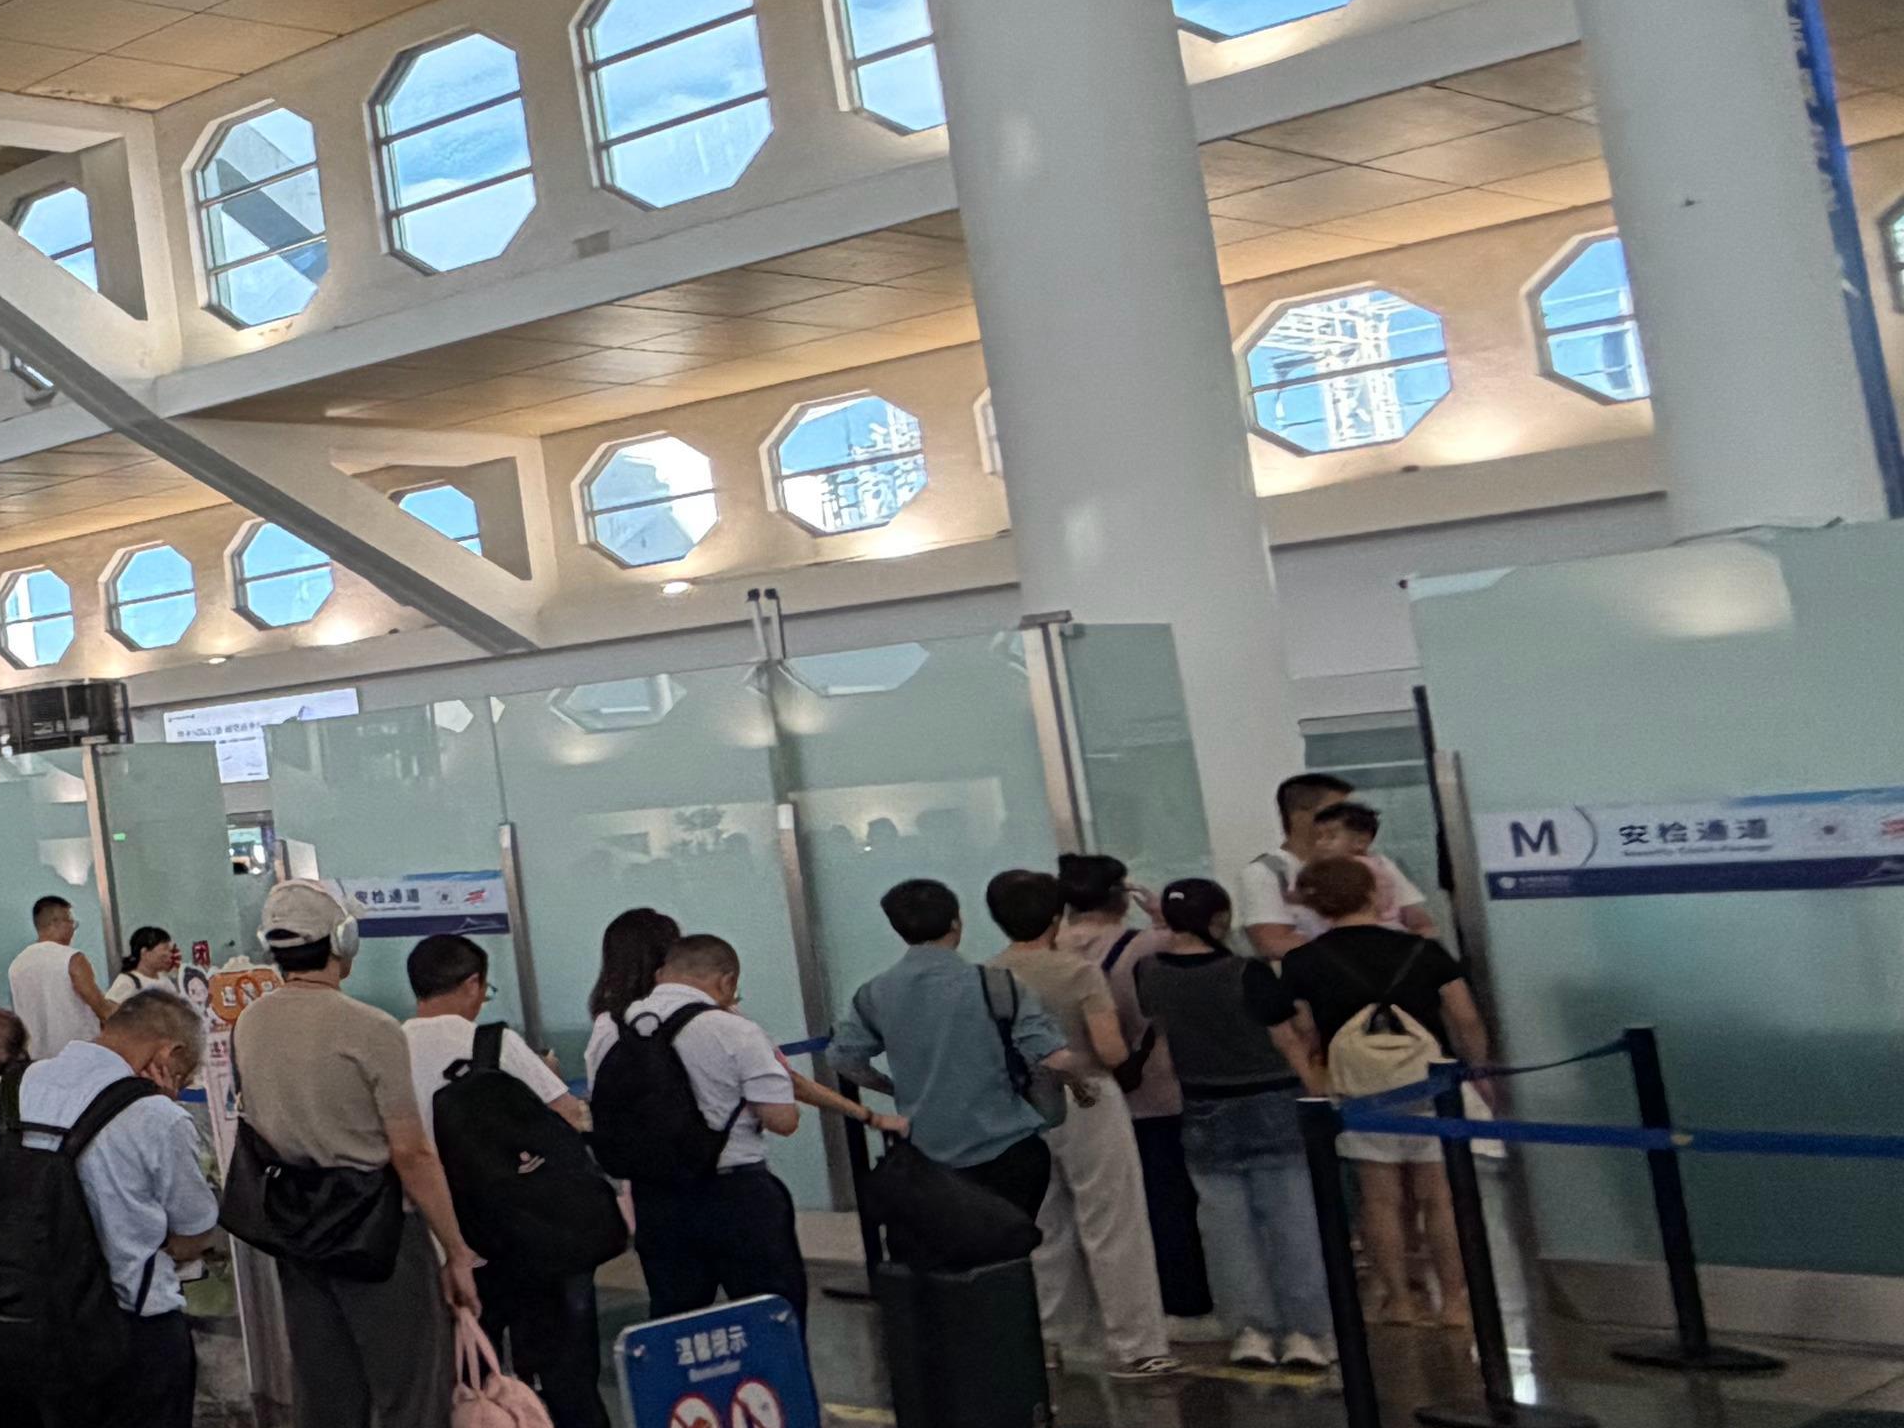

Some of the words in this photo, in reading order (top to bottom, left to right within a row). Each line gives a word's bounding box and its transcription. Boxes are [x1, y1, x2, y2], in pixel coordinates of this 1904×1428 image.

[1509, 819, 1560, 857] M
[1619, 818, 1769, 846] 安检通道
